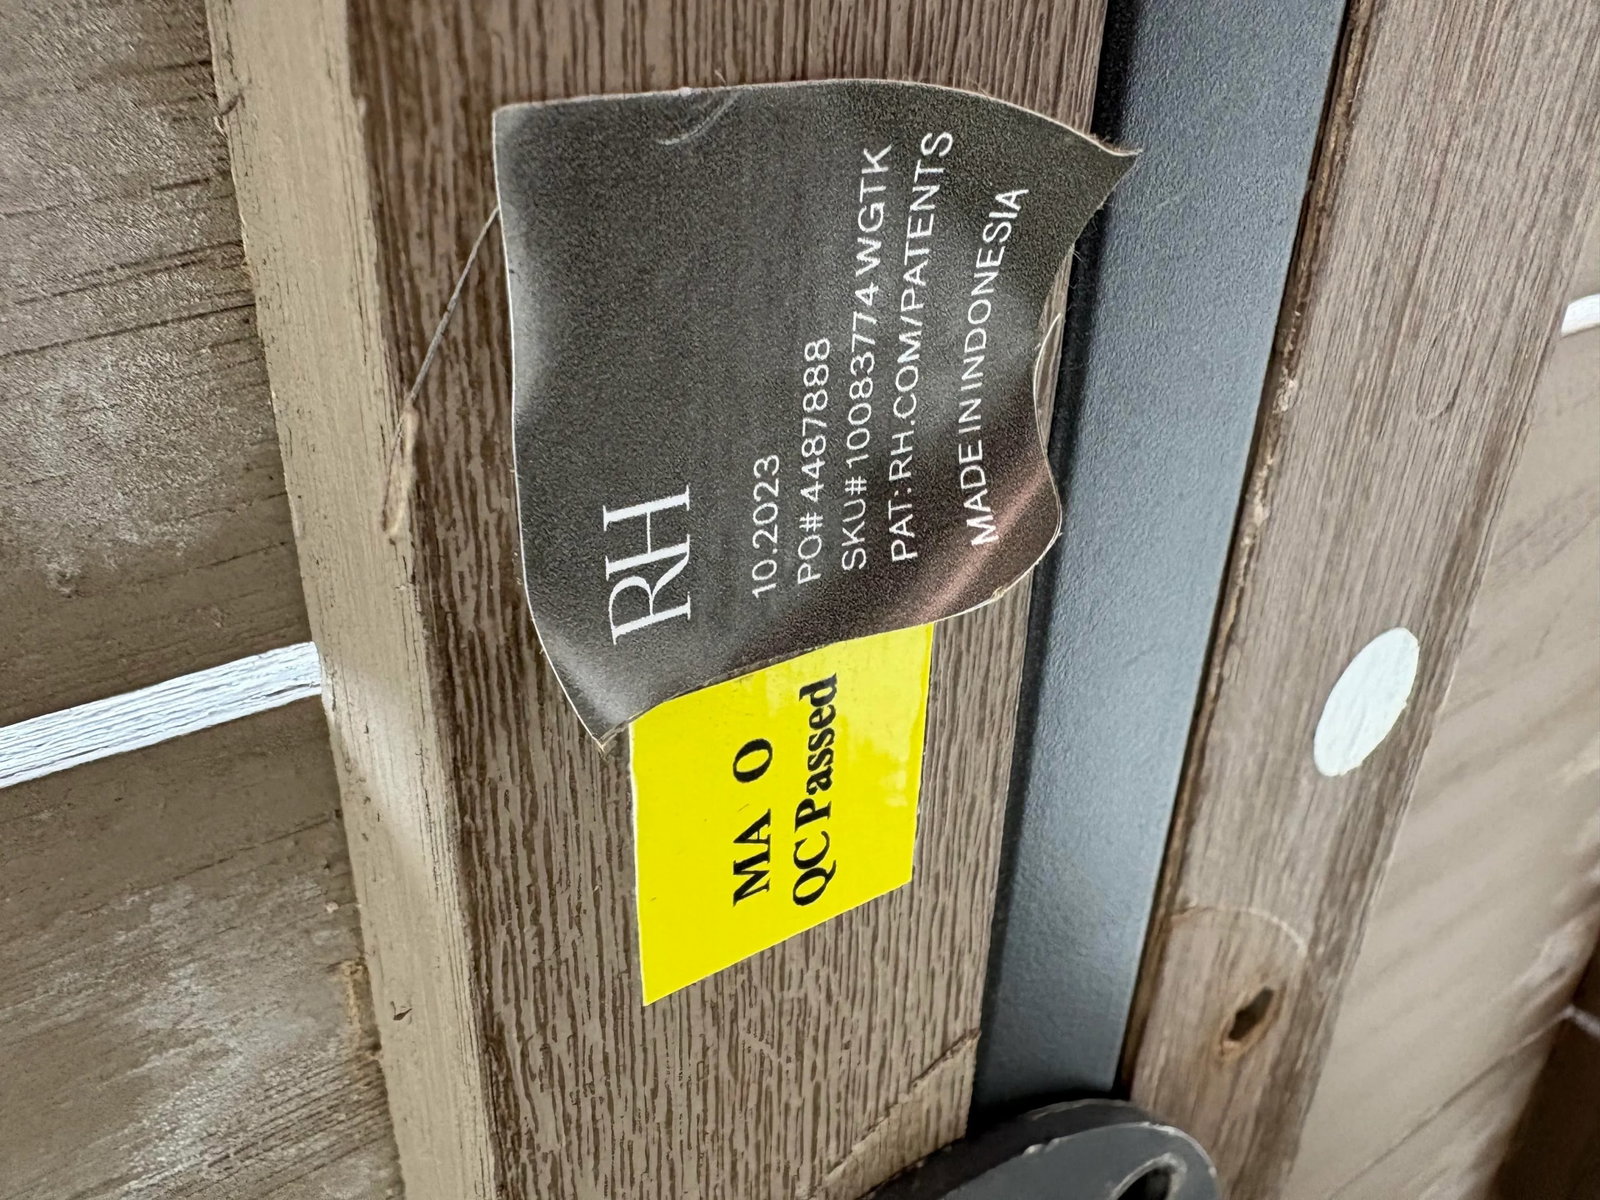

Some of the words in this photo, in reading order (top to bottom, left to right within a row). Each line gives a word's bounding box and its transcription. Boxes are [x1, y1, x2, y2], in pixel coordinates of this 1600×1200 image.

[855, 144, 892, 277] WGTK
[889, 131, 953, 482] RH.COM/PATENTS
[961, 188, 1030, 391] INDONESIA
[800, 337, 830, 502] 4487888
[846, 281, 879, 469] 10083774
[958, 397, 982, 434] IN
[752, 454, 779, 598] 10.2023
[798, 511, 824, 585] PO#
[842, 475, 867, 571] SKU#
[888, 490, 918, 562] PAT:
[958, 439, 1000, 546] MADE
[603, 484, 690, 645] RH
[733, 737, 773, 784] O
[794, 672, 838, 833] Passed
[733, 808, 771, 907] MA
[793, 830, 837, 906] QC
